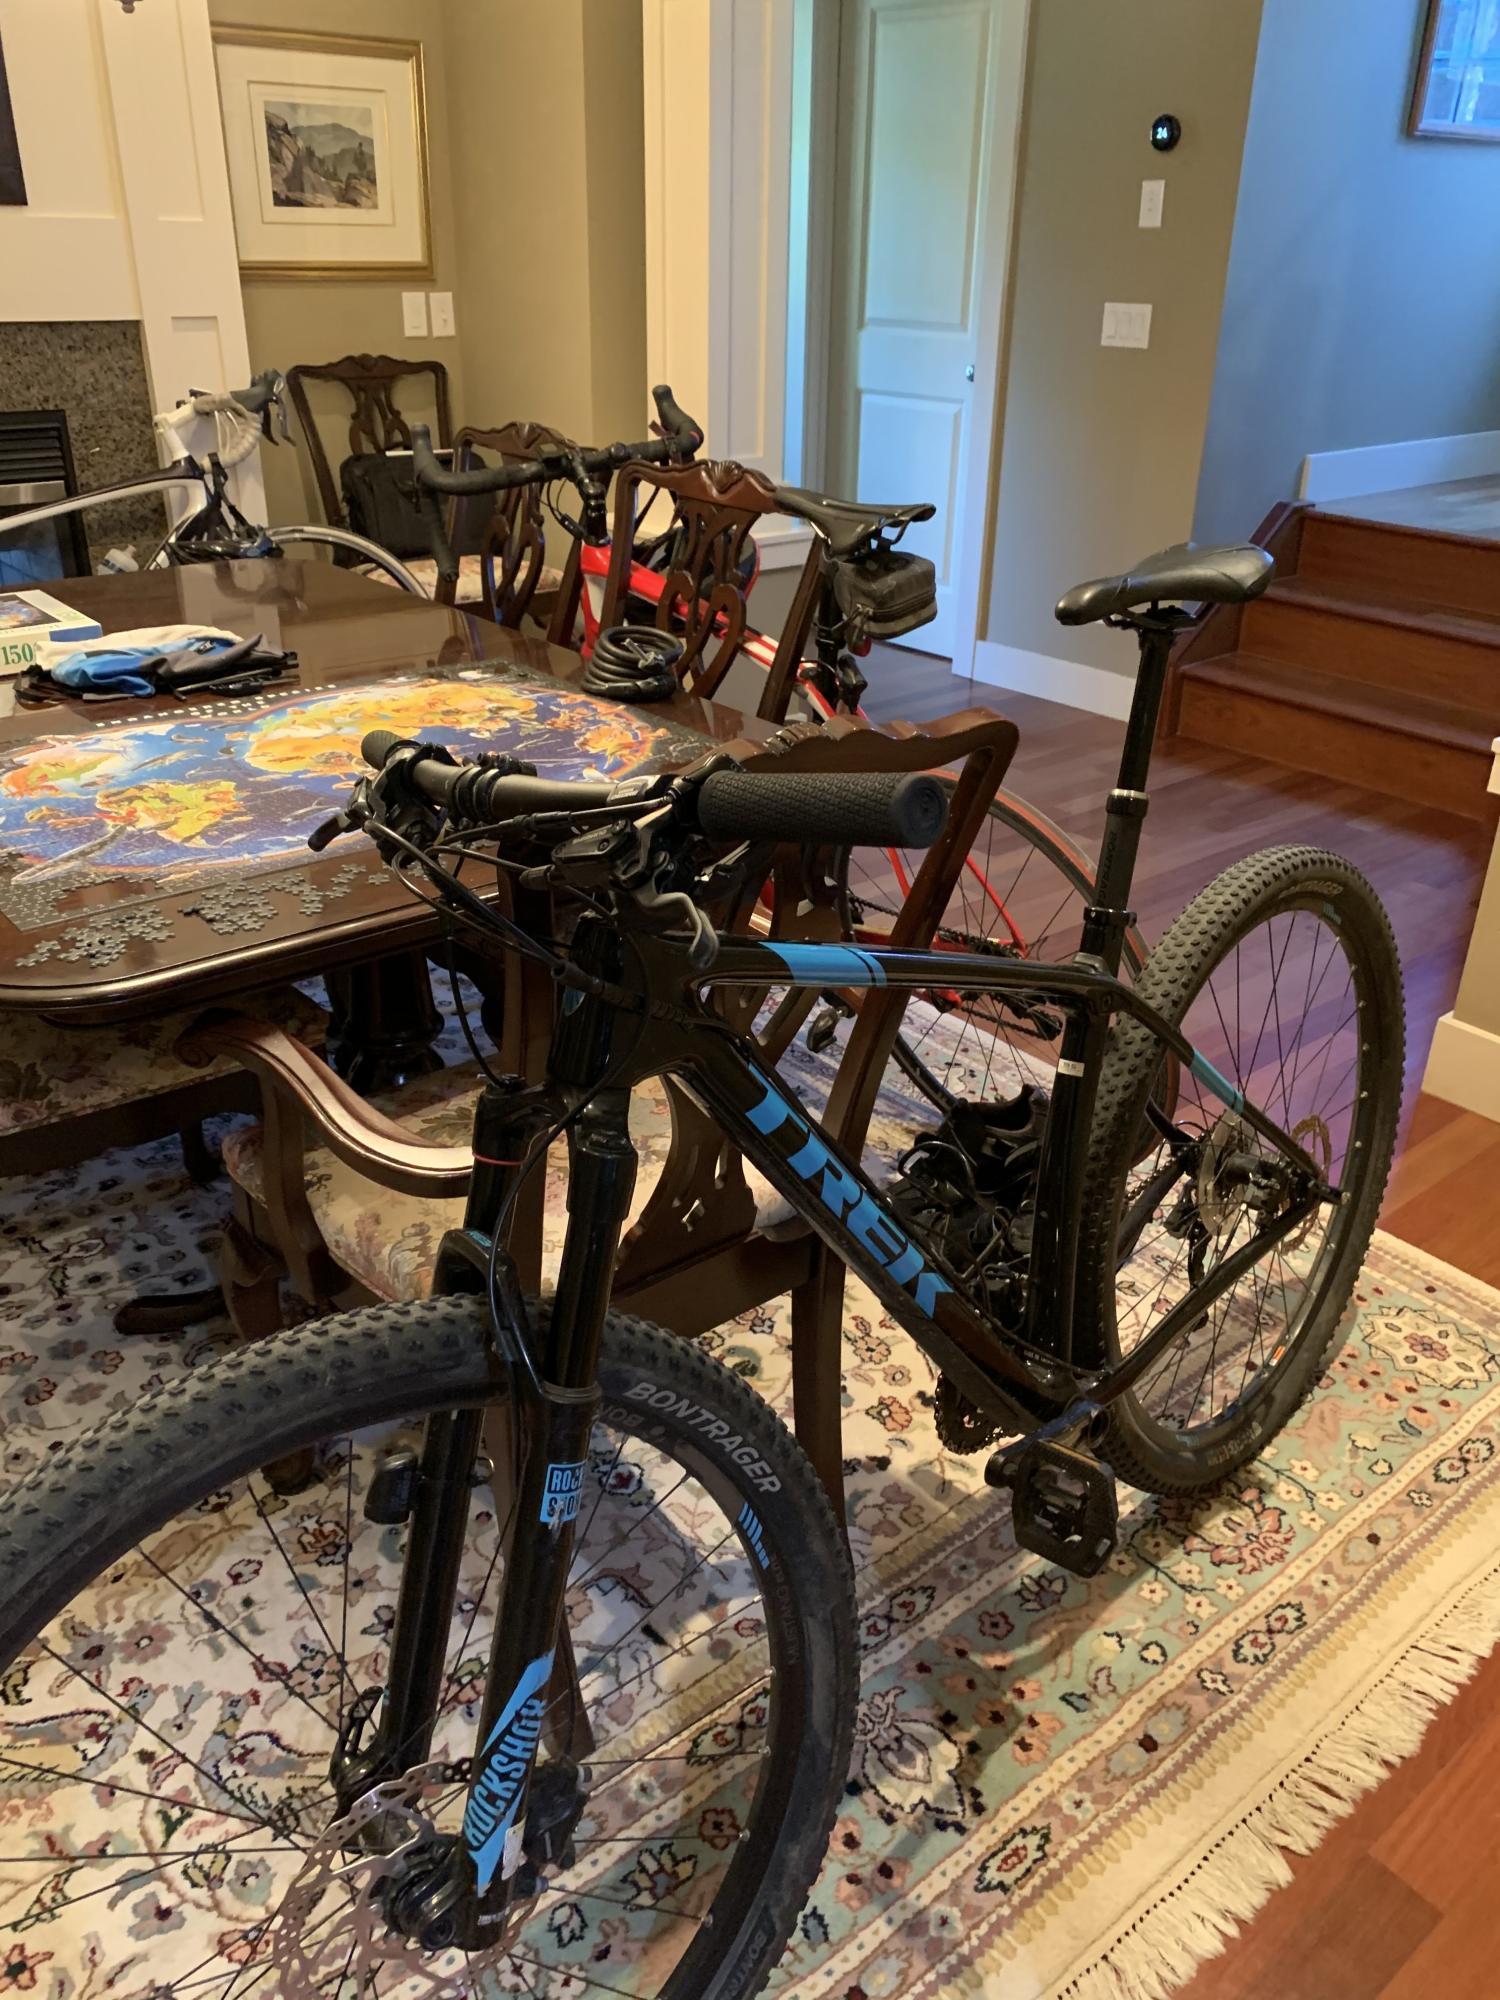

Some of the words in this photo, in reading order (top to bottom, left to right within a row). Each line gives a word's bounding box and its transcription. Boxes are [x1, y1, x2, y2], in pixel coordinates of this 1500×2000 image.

[1, 642, 37, 666] 150
[745, 1061, 954, 1319] TREK
[622, 1382, 782, 1494] BONTRAGER
